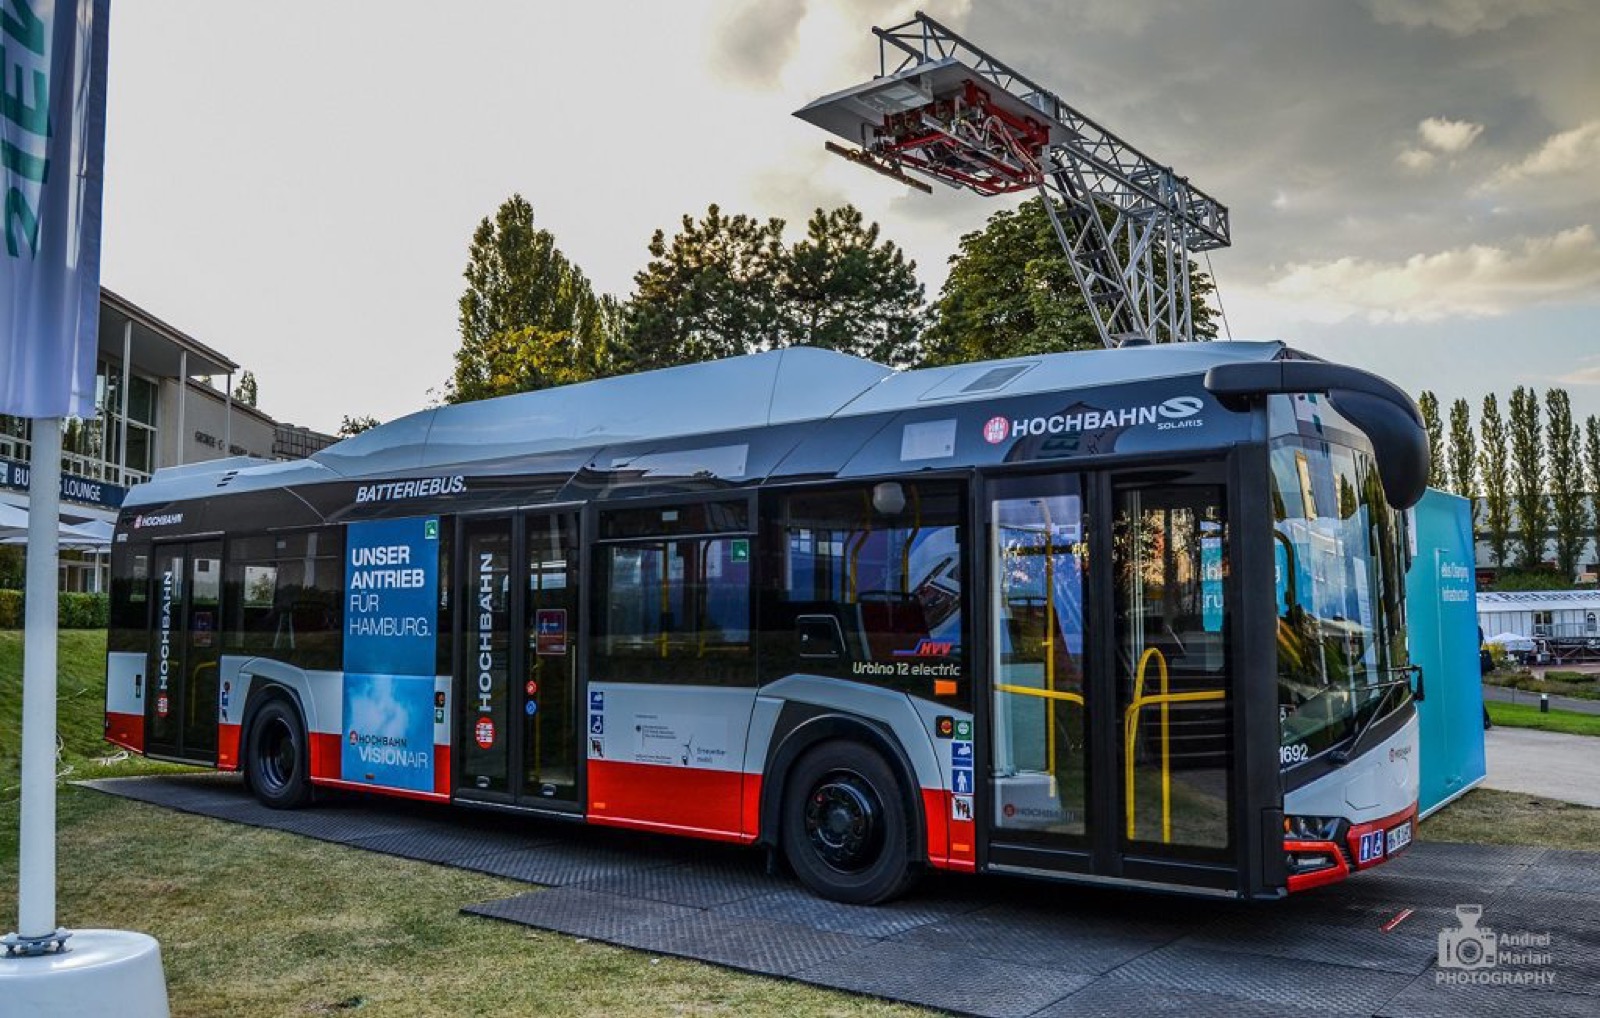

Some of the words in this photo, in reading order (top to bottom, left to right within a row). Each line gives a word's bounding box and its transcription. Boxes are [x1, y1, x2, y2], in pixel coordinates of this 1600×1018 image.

[1012, 405, 1157, 437] HOCHBAHN
[1158, 419, 1204, 430] SOLARIS
[63, 478, 101, 502] LOUNGE
[355, 475, 467, 503] BATTERIEBUS.
[352, 545, 410, 566] UNSER
[350, 569, 425, 590] ANTRIEB
[349, 591, 379, 613] FÜR
[160, 571, 173, 690] HOCHBAHN
[349, 617, 432, 636] HAMBURG.
[479, 553, 493, 713] HOCHBAHN
[921, 642, 952, 656] HVV
[852, 661, 895, 675] Urbino
[896, 662, 909, 675] 12
[910, 663, 961, 676] electric
[359, 733, 408, 748] HOCHBAHN
[358, 745, 429, 769] VISIONAIR
[1279, 743, 1309, 764] 1692
